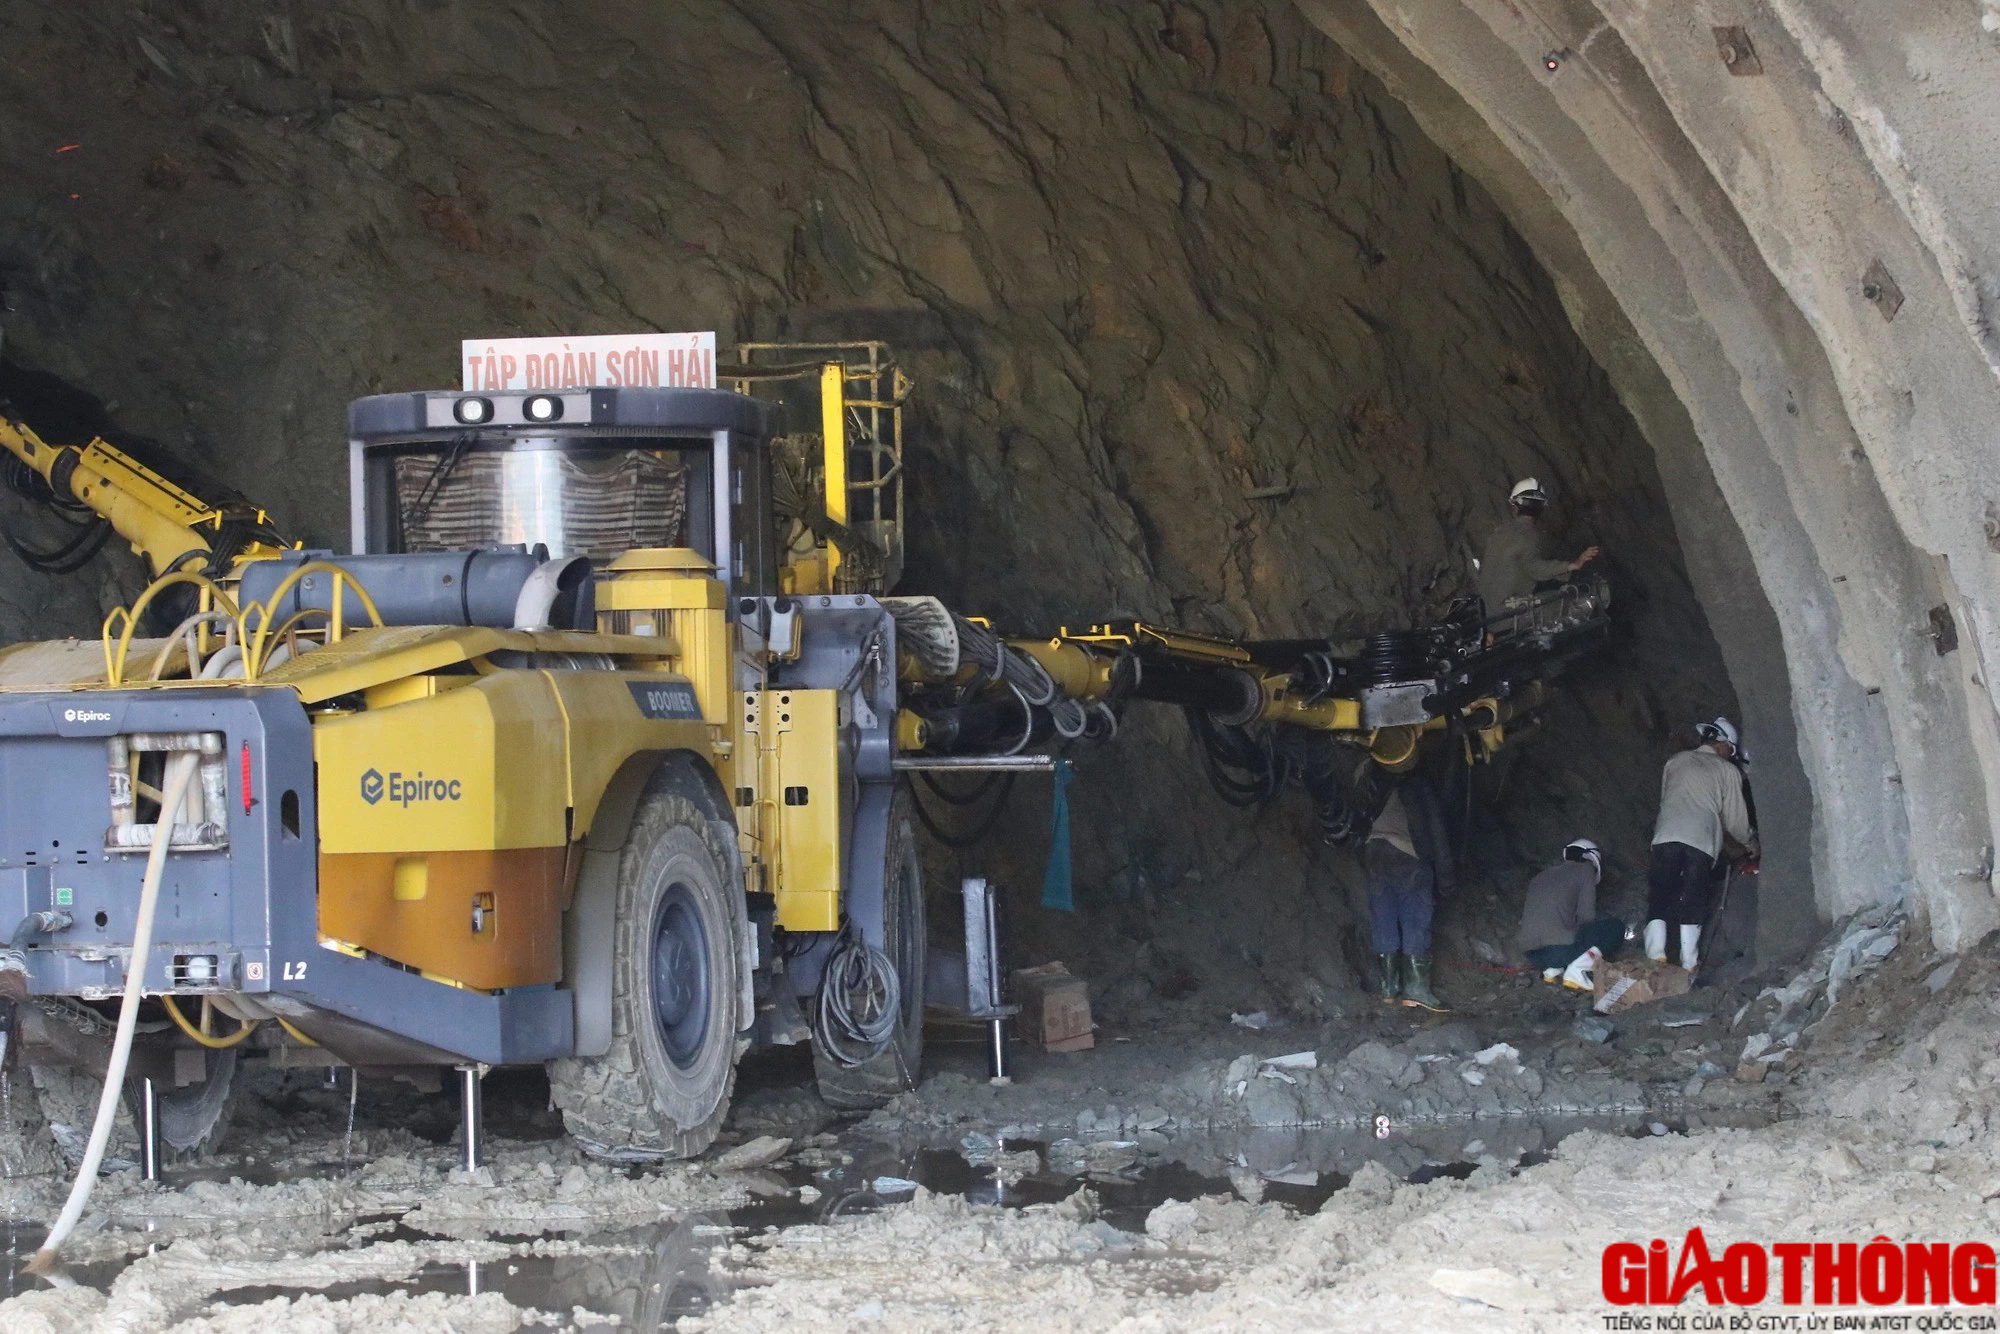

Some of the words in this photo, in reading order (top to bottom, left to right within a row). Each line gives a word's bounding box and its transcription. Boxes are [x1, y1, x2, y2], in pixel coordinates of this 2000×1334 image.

[526, 343, 597, 390] ĐOÀN
[606, 346, 659, 387] SƠN
[668, 335, 711, 389] HẢI
[647, 690, 695, 712] BOOMER
[77, 710, 111, 723] Epiroc
[389, 771, 461, 808] Epiroc
[283, 961, 307, 980] L2
